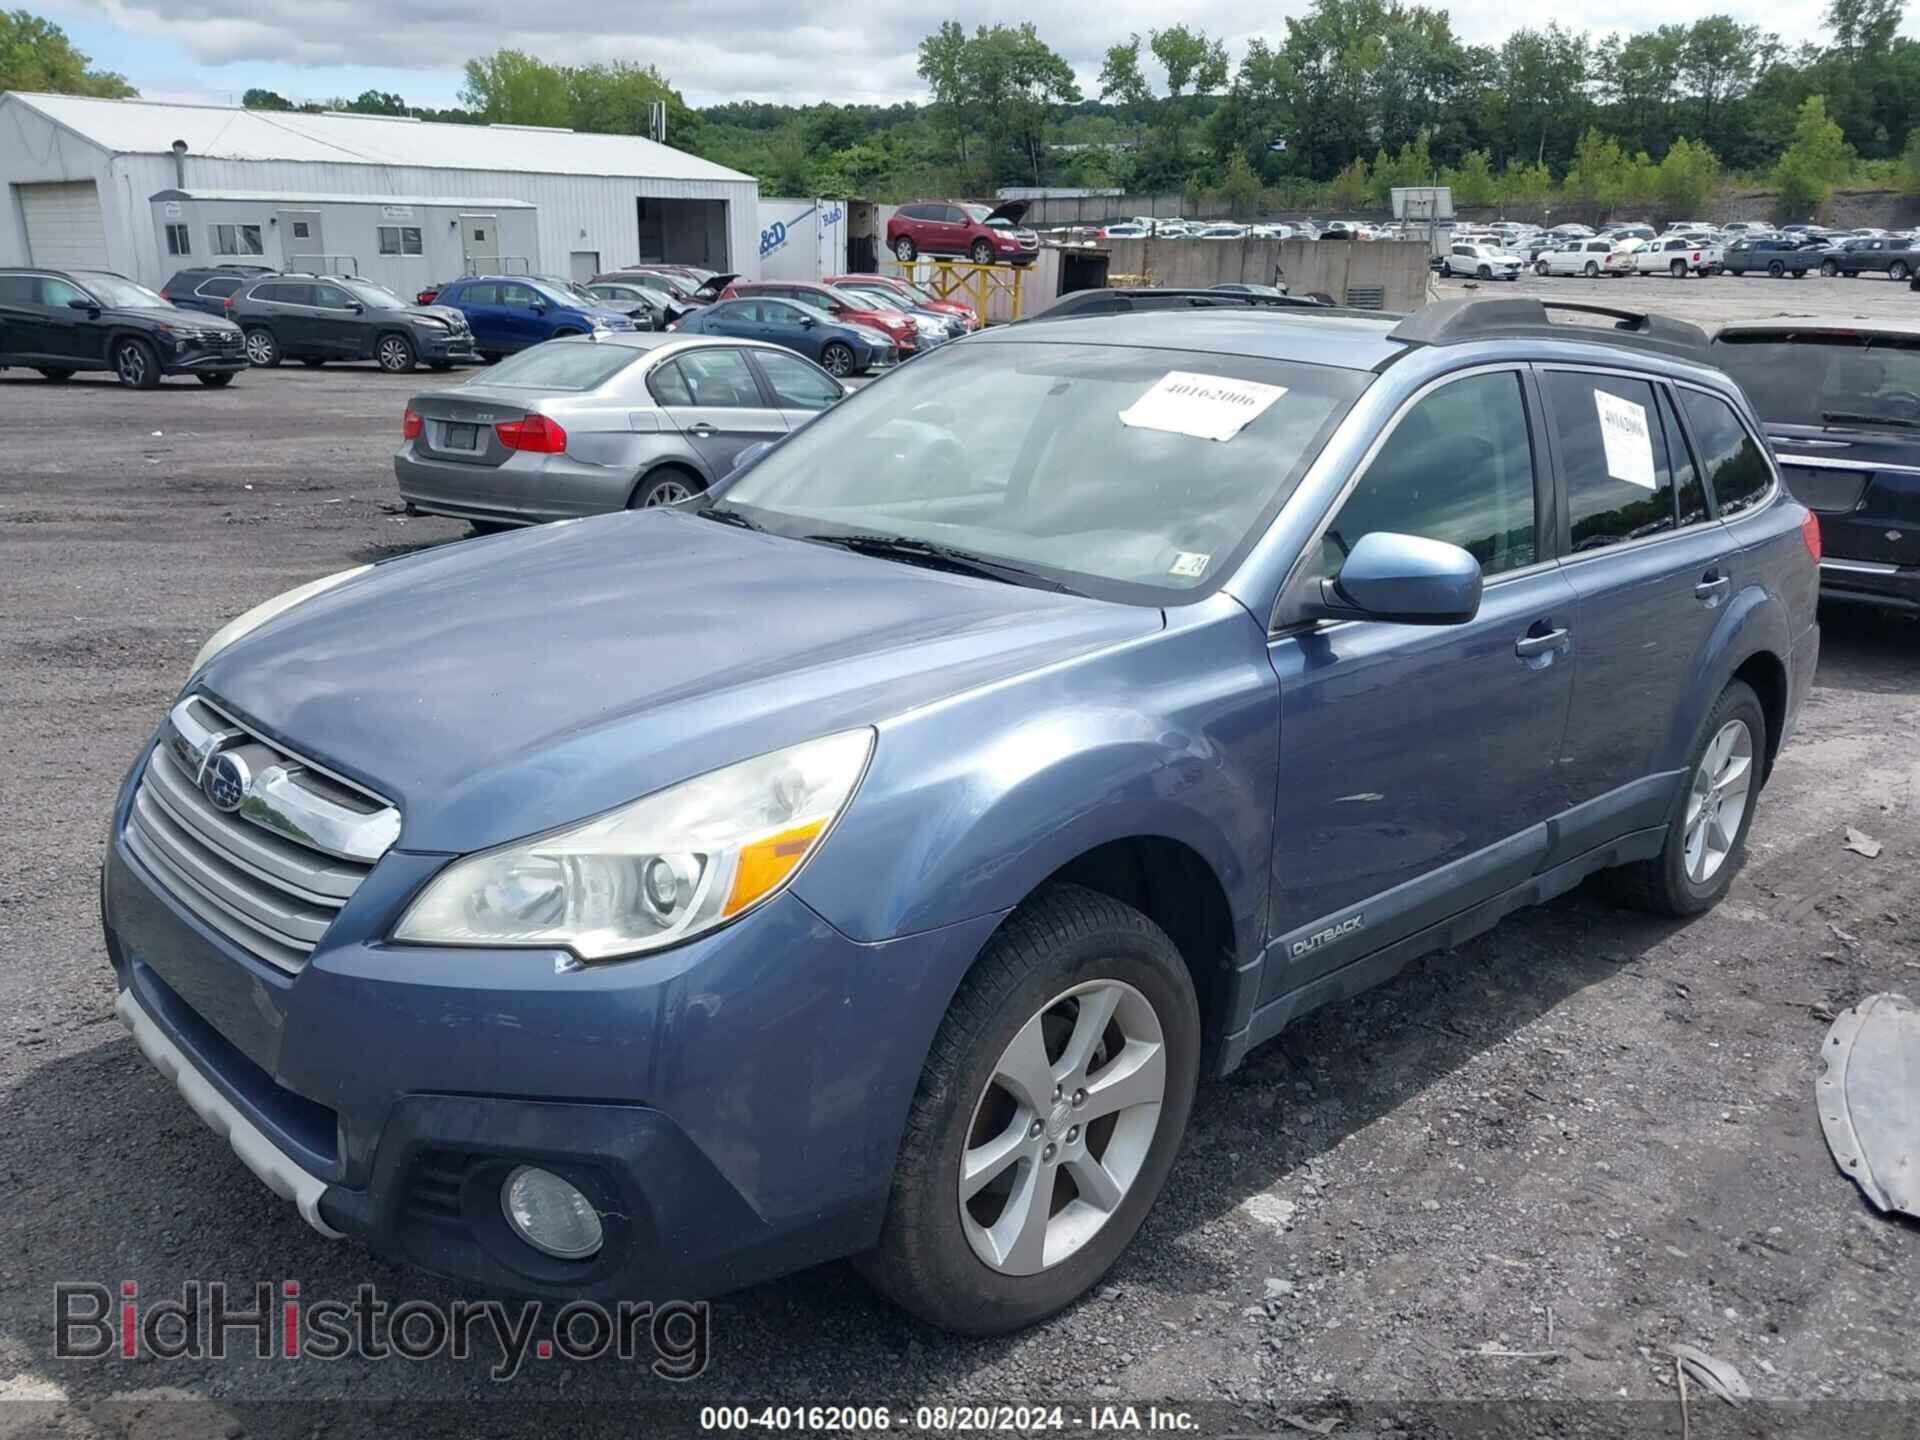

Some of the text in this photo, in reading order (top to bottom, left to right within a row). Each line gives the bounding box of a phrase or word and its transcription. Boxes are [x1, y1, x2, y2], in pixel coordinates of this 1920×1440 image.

[760, 221, 786, 254] &D
[1165, 384, 1256, 406] 40162006
[1292, 914, 1363, 956] OUTBACK
